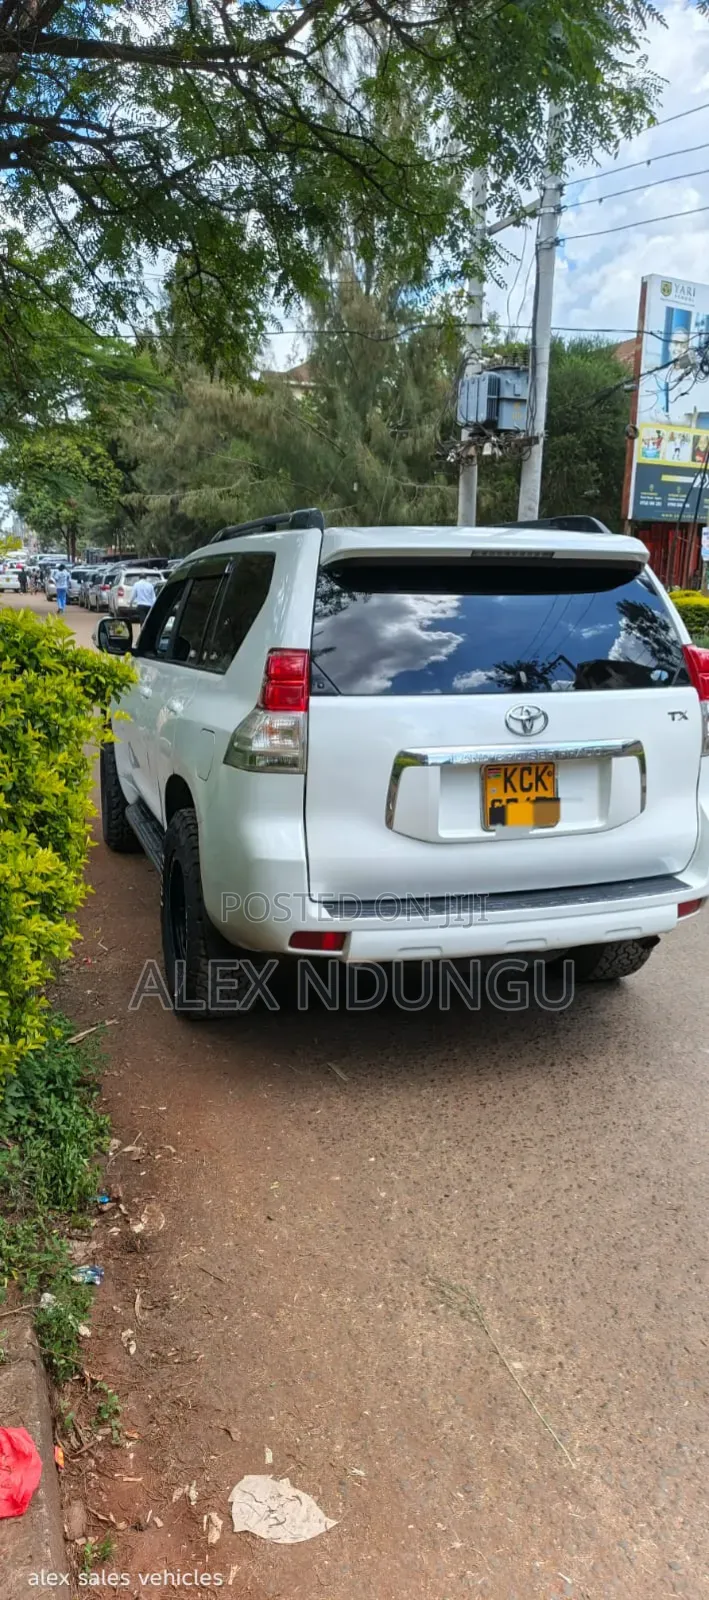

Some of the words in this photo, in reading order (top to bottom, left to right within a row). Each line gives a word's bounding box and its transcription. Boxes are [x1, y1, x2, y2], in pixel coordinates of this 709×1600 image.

[674, 283, 696, 297] YARI
[667, 710, 689, 722] TX
[503, 765, 549, 794] KCK
